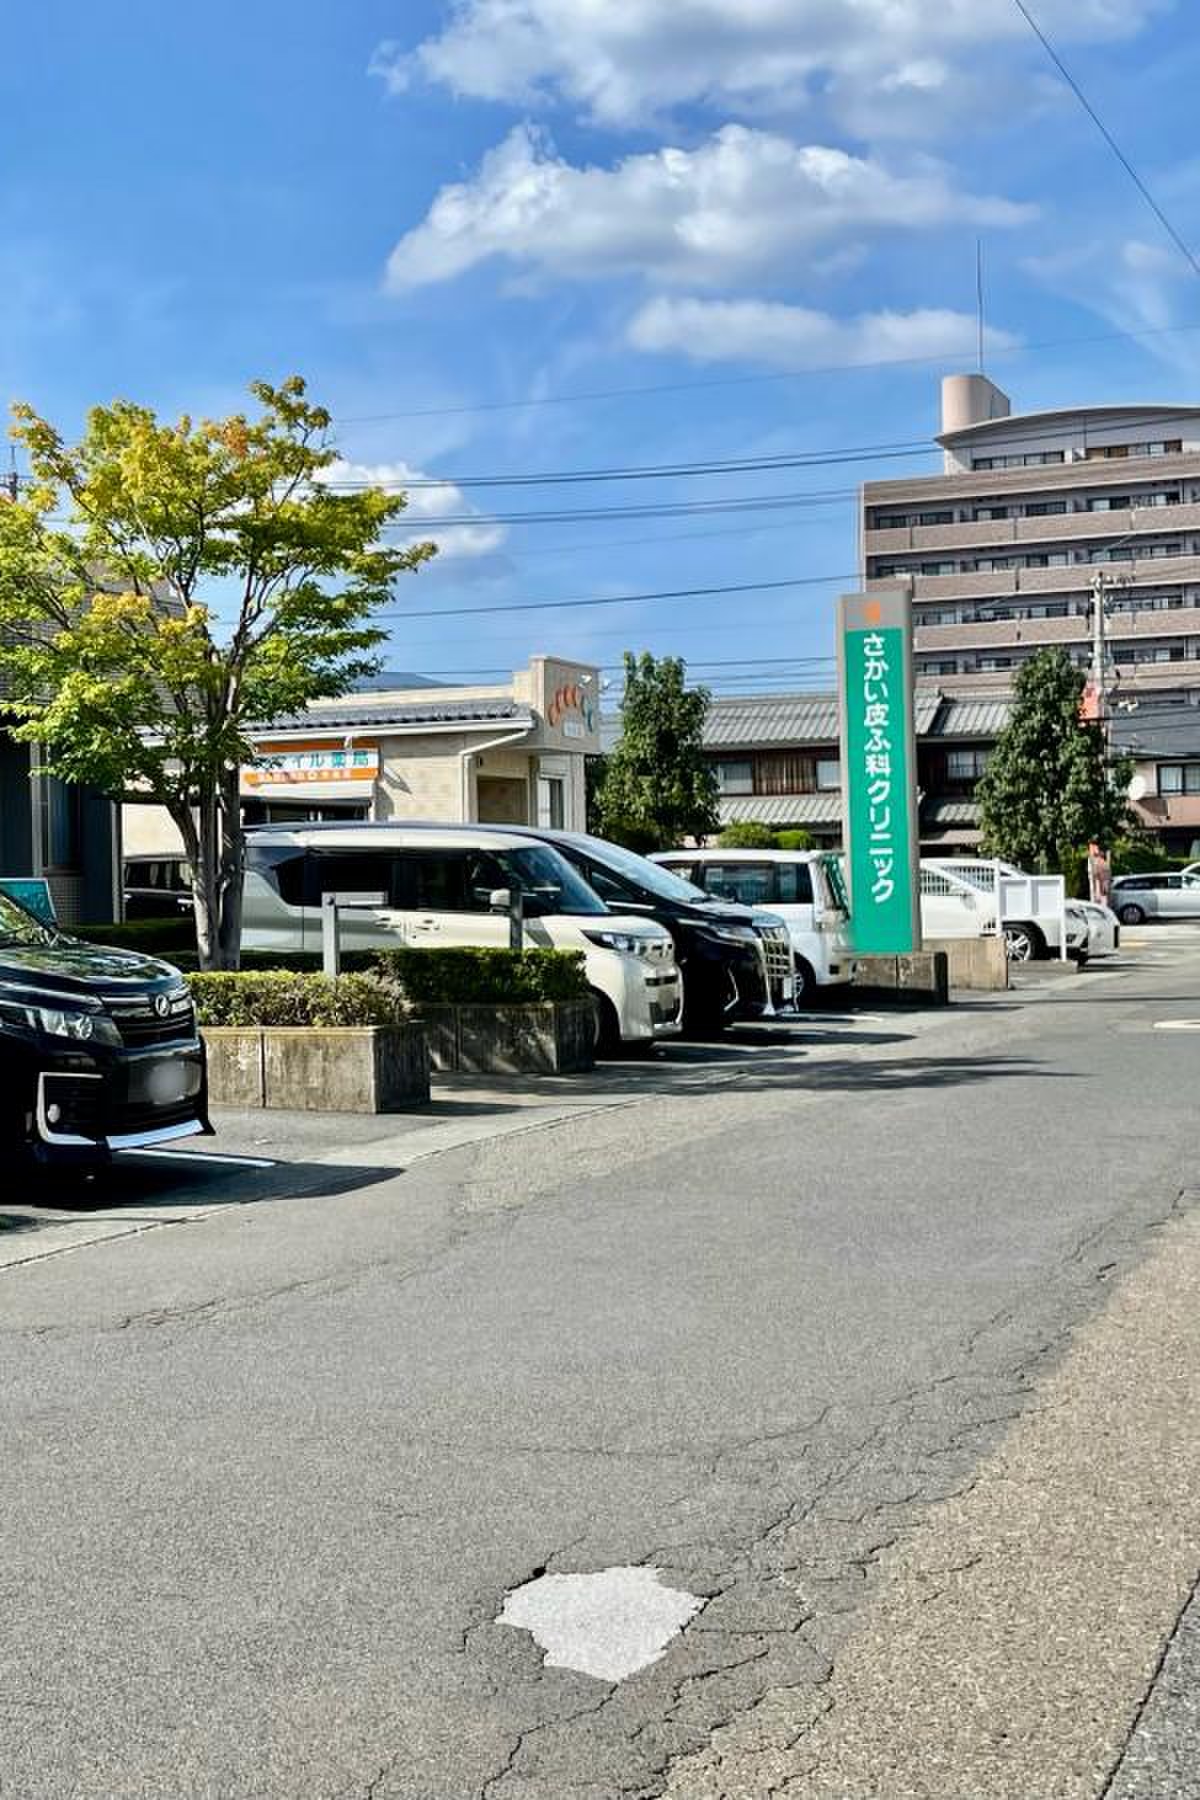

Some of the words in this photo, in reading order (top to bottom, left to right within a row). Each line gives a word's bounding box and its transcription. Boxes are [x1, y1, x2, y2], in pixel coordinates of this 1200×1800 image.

[862, 633, 895, 902] さかい皮ふ科クリニック
